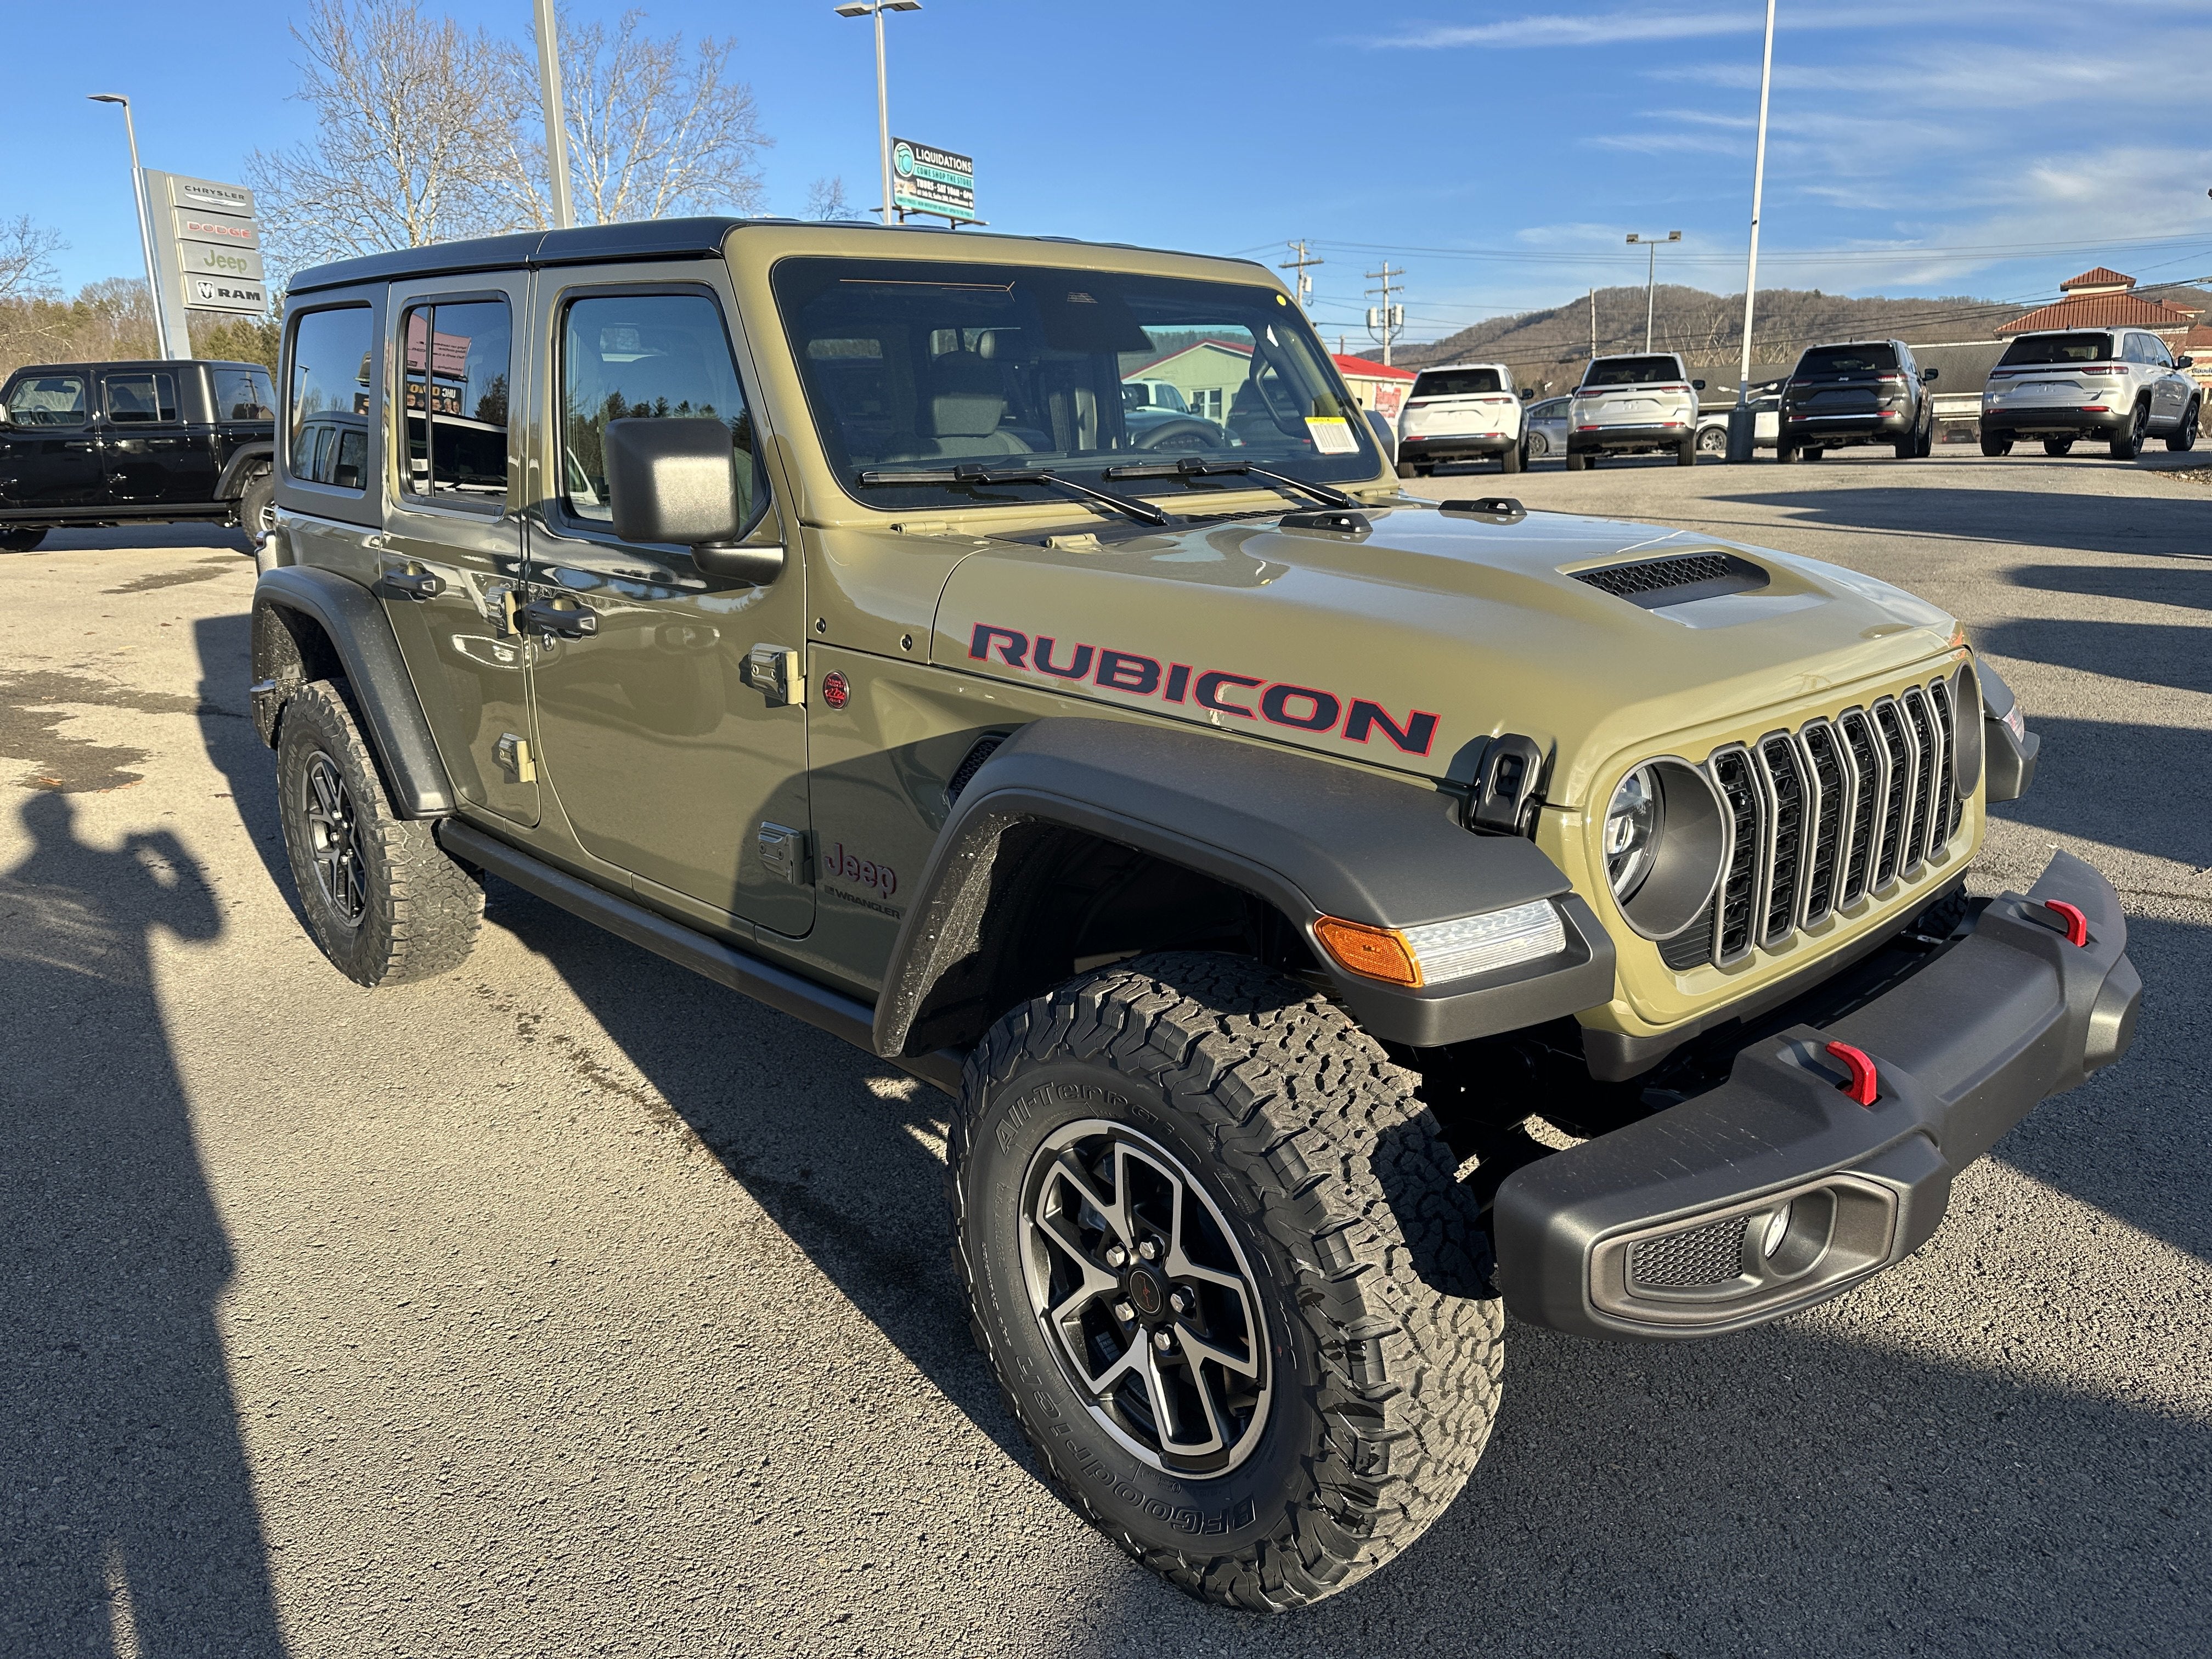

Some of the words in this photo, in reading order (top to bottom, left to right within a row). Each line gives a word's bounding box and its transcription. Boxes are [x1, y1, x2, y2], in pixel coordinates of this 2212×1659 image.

[916, 148, 972, 172] LIQUIDATIONS
[917, 167, 931, 177] COME
[933, 170, 945, 179] SHOP
[947, 174, 956, 183] THE
[957, 177, 972, 187] STORE
[184, 185, 245, 200] CHRYSLER
[187, 221, 252, 239] DODGE
[203, 250, 247, 273] Jeep
[217, 287, 261, 301] RAM
[968, 622, 1441, 757] RUBICON
[824, 842, 896, 899] Jeep
[835, 889, 901, 920] WRANGLER
[1015, 1355, 1256, 1537] BFGoodrich
